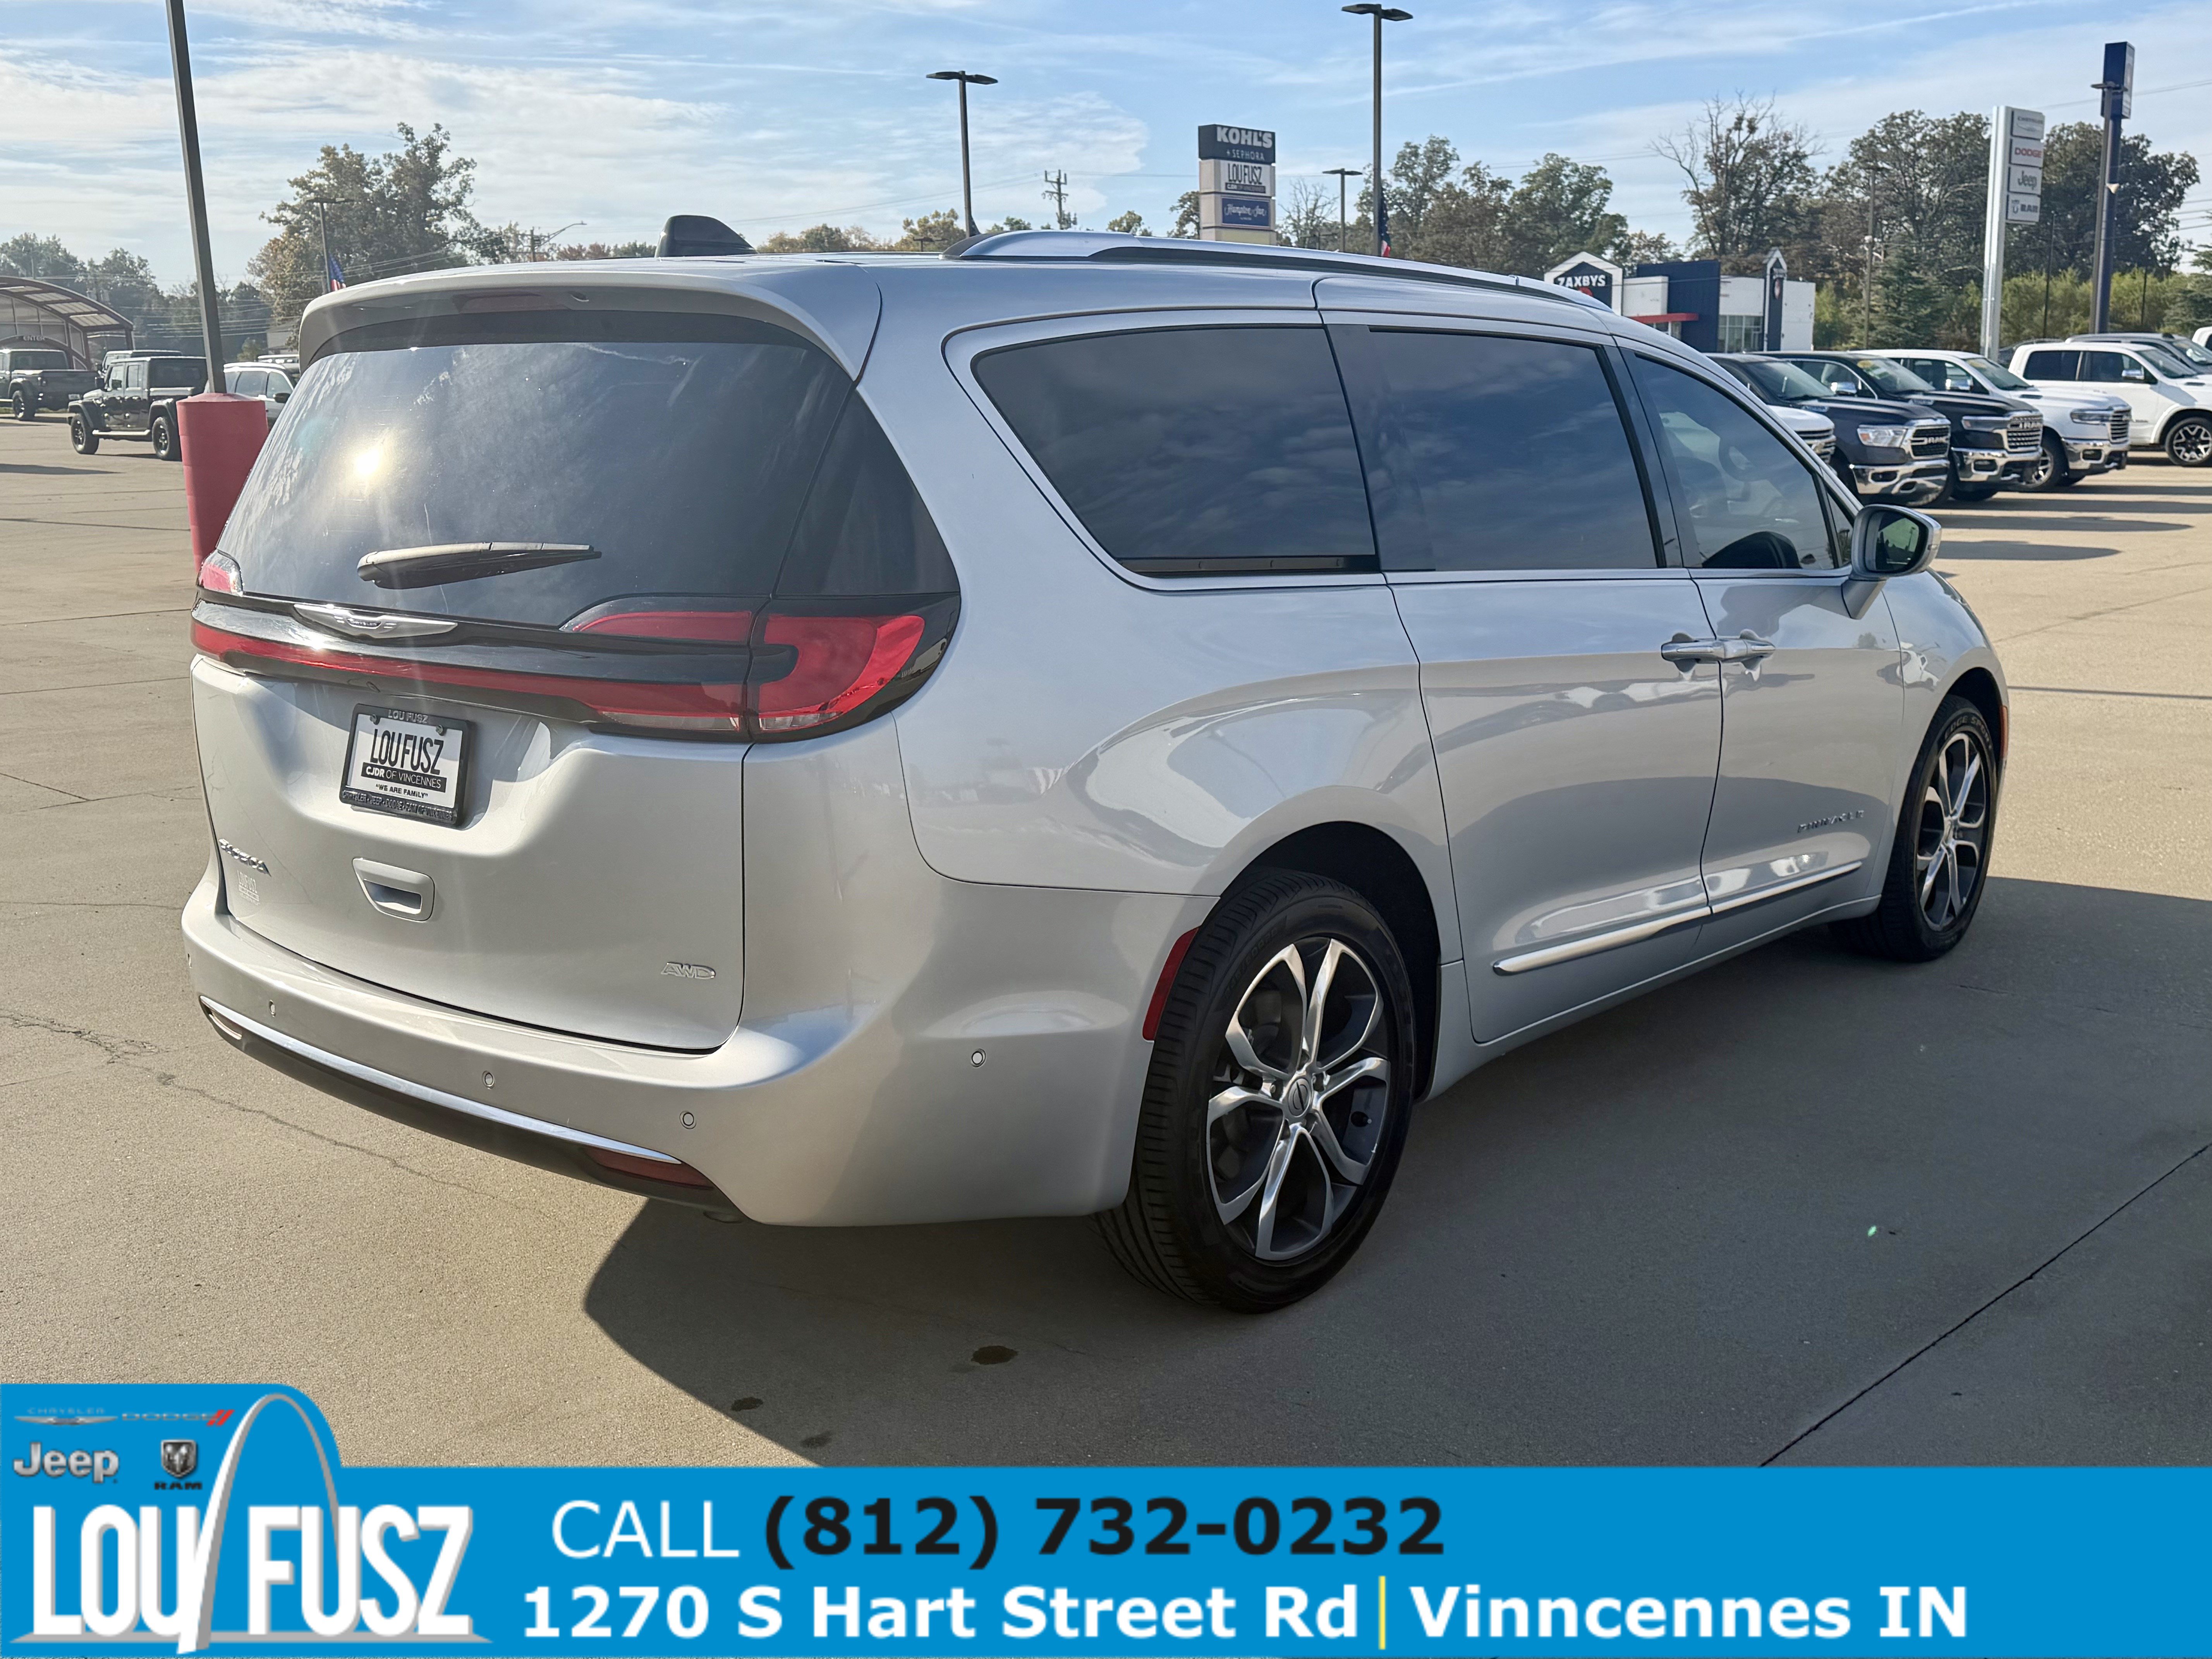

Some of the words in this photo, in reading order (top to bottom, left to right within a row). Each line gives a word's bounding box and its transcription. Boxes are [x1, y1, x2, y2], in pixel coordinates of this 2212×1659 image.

[1216, 126, 1273, 148] KOHL'S
[1232, 149, 1265, 161] SEPHORA
[2014, 147, 2042, 158] DODGE
[2018, 170, 2037, 190] Jeep
[2020, 204, 2038, 213] RAM
[1557, 275, 1606, 288] ZAXBYS
[388, 709, 405, 720] LOU
[406, 712, 428, 724] FUSZ
[370, 728, 402, 767] LOU
[400, 733, 444, 775] FUSZ
[366, 766, 385, 778] CJDR
[386, 769, 397, 778] OF
[398, 771, 441, 788] VINCENNES
[389, 785, 402, 794] ARE
[661, 961, 716, 980] AWD
